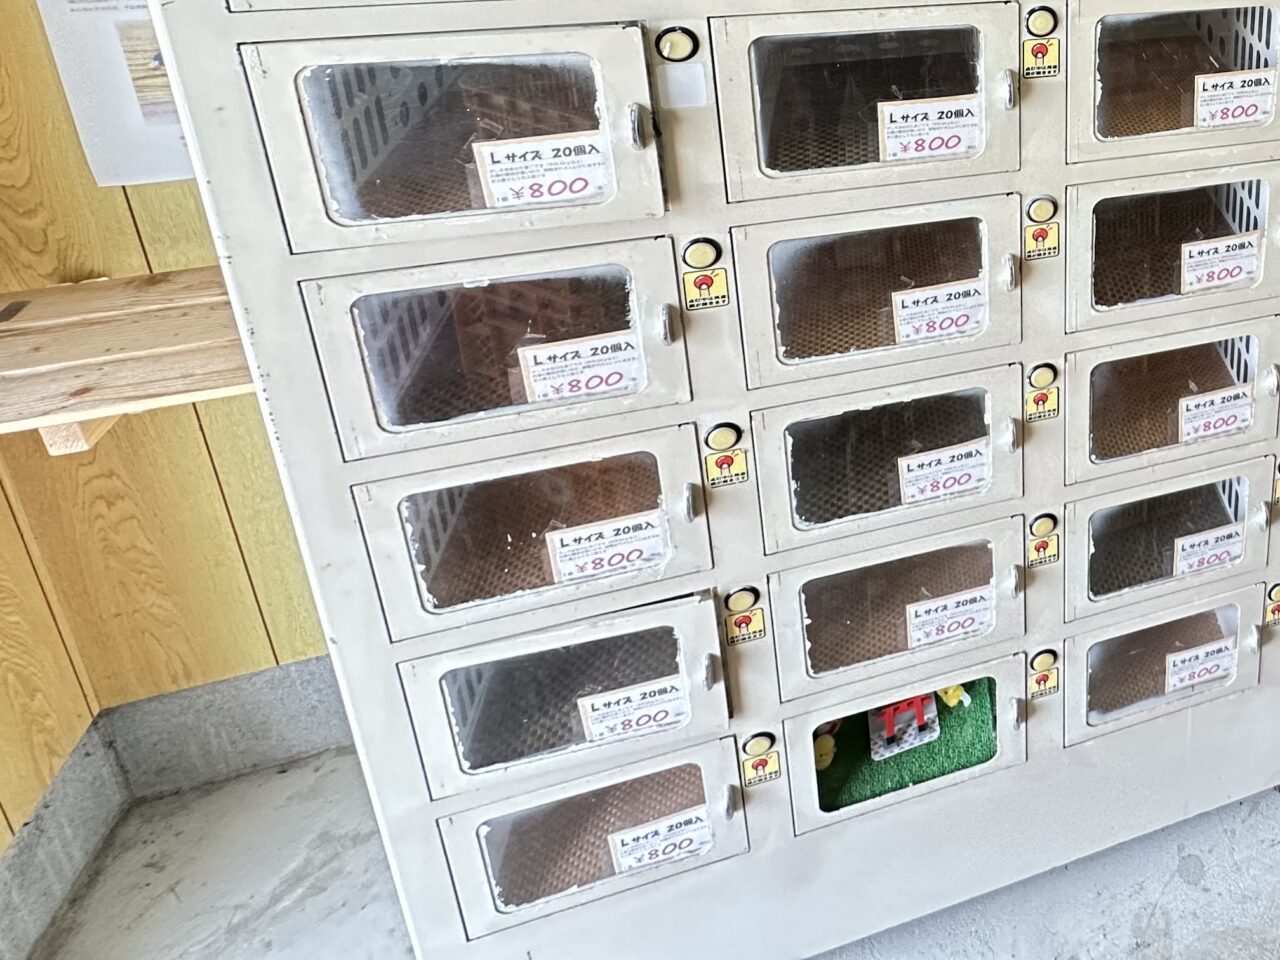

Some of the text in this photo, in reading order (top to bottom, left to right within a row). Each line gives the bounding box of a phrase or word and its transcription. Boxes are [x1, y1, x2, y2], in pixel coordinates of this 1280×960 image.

[1202, 78, 1270, 92] Lサイズ 20個入
[890, 108, 975, 124] Lサイズ 20個入
[1208, 103, 1258, 121] ¥800
[490, 144, 600, 165] Lサイズ 20個入
[900, 135, 962, 154] ¥800
[511, 177, 589, 200] ¥800
[1188, 242, 1254, 259] Lサイズ 20個入
[1195, 265, 1242, 283] ¥800
[901, 288, 982, 310] Lサイズ 20個入
[912, 314, 970, 335] ¥800
[533, 342, 635, 366] Lサイズ 20個入
[551, 371, 624, 395] ¥800
[917, 473, 972, 495] ¥800
[575, 549, 644, 574] ¥800
[923, 617, 975, 639] ¥800
[606, 710, 669, 734] ¥800
[633, 838, 694, 863] ¥800
